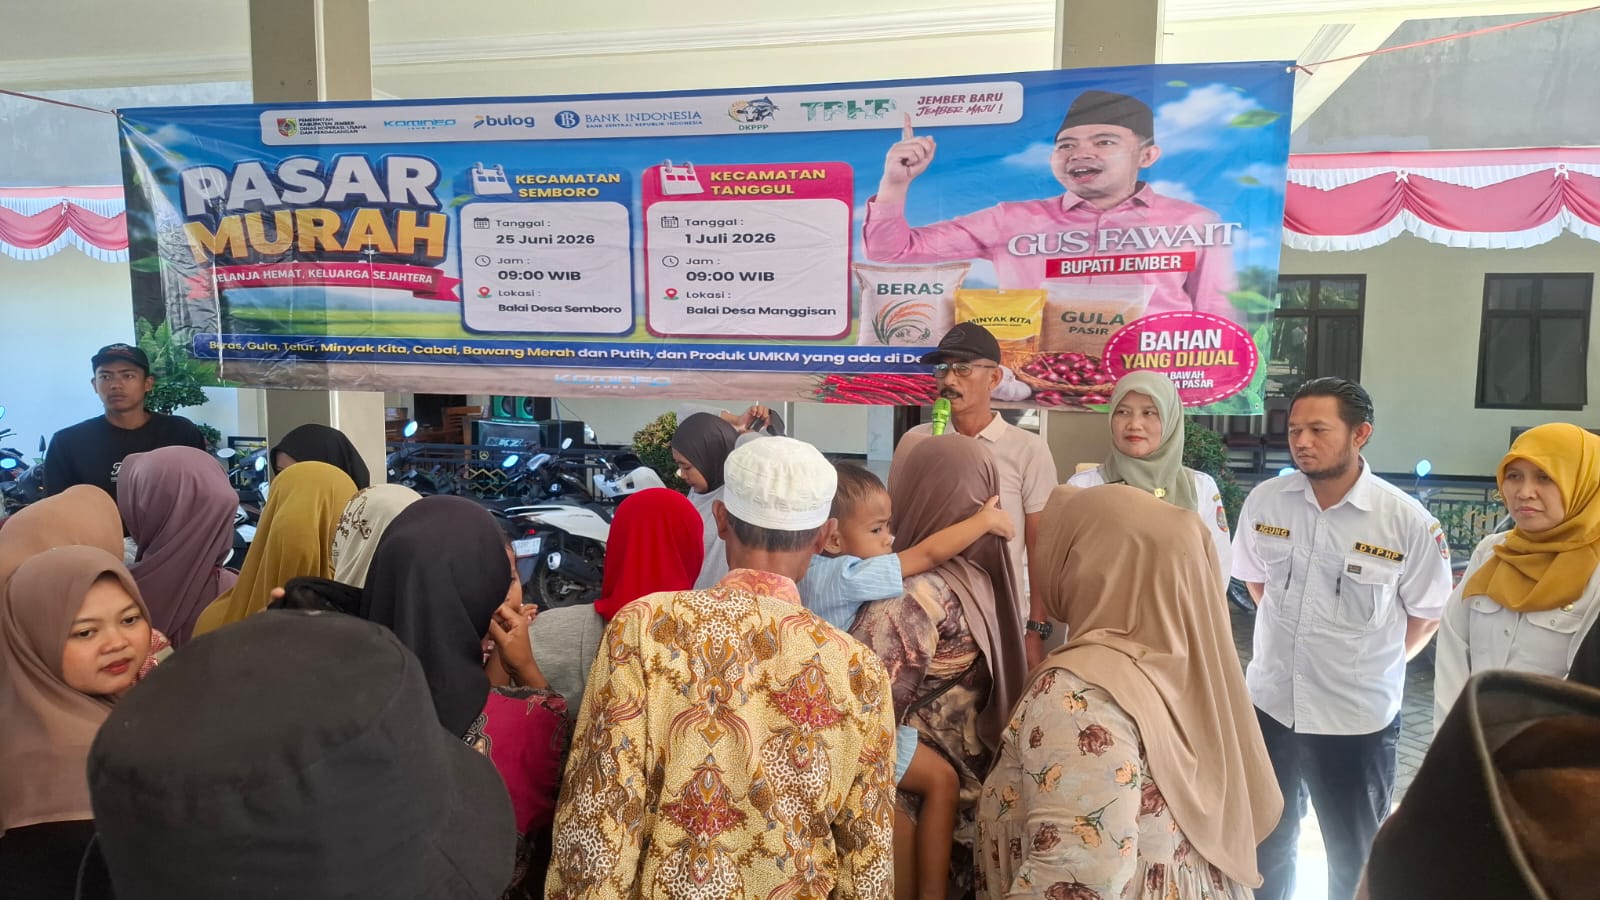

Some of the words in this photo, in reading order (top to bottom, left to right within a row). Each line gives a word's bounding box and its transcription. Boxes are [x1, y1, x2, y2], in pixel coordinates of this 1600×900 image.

[917, 95, 965, 105] JEMBER
[969, 92, 1003, 103] BARU
[585, 114, 620, 123] BANK
[626, 111, 702, 122] INDONESIA
[915, 106, 962, 117] JEMBER
[486, 115, 535, 128] bulog
[515, 173, 621, 185] KECAMATAN
[710, 169, 826, 181] KECAMATAN
[181, 154, 440, 216] PASAR
[710, 184, 794, 195] TANGGUL
[519, 187, 600, 198] SEMBORO
[496, 219, 545, 229] Tanggal
[685, 218, 737, 228] Tanggal
[183, 207, 447, 264] MURAH
[496, 234, 515, 244] 25
[519, 234, 553, 244] Juni
[557, 234, 595, 244] 2026
[685, 233, 691, 243] 1
[696, 233, 728, 244] Juli
[732, 233, 776, 244] 2026
[1008, 230, 1090, 256] GUS
[1097, 221, 1242, 251] FAWAIT
[686, 257, 714, 265] Jam
[1060, 258, 1115, 275] BUPATI
[1117, 255, 1182, 272] JEMBER
[263, 269, 305, 279] HEMAT,
[308, 269, 370, 279] KELUARGA
[372, 270, 433, 284] SEJAHTERA
[498, 271, 544, 281] 09:00
[548, 271, 581, 281] WIB
[686, 271, 735, 281] 09:00
[739, 271, 775, 281] WIB
[498, 289, 535, 297] Lokasi
[876, 282, 945, 296] BERAS
[686, 291, 725, 299] Lokasi
[498, 303, 528, 312] Balai
[531, 304, 562, 313] Desa
[564, 304, 622, 313] Semboro
[686, 305, 719, 314] Balai
[722, 306, 756, 315] Desa
[759, 306, 836, 317] Manggisan
[1009, 316, 1032, 324] KITA
[1060, 311, 1126, 326] GULA
[1068, 325, 1109, 336] PASIR
[1140, 328, 1222, 352] BAHAN
[320, 343, 375, 355] Minyak
[377, 344, 410, 355] Kita,
[413, 345, 460, 356] Cabai,
[463, 346, 525, 358] Bawang
[527, 347, 575, 357] Merah
[578, 348, 608, 358] dan
[610, 349, 654, 360] Putih,
[656, 350, 687, 359] dan
[690, 351, 746, 361] Produk
[749, 352, 800, 362] UMKM
[802, 353, 845, 364] yang
[847, 353, 882, 363] ada
[884, 353, 900, 363] di
[1122, 352, 1172, 369] YANG
[1175, 350, 1239, 367] DIJUAL
[1170, 370, 1205, 380] BAWAH
[1182, 379, 1214, 389] PASAR
[1258, 524, 1289, 537] AGUNG
